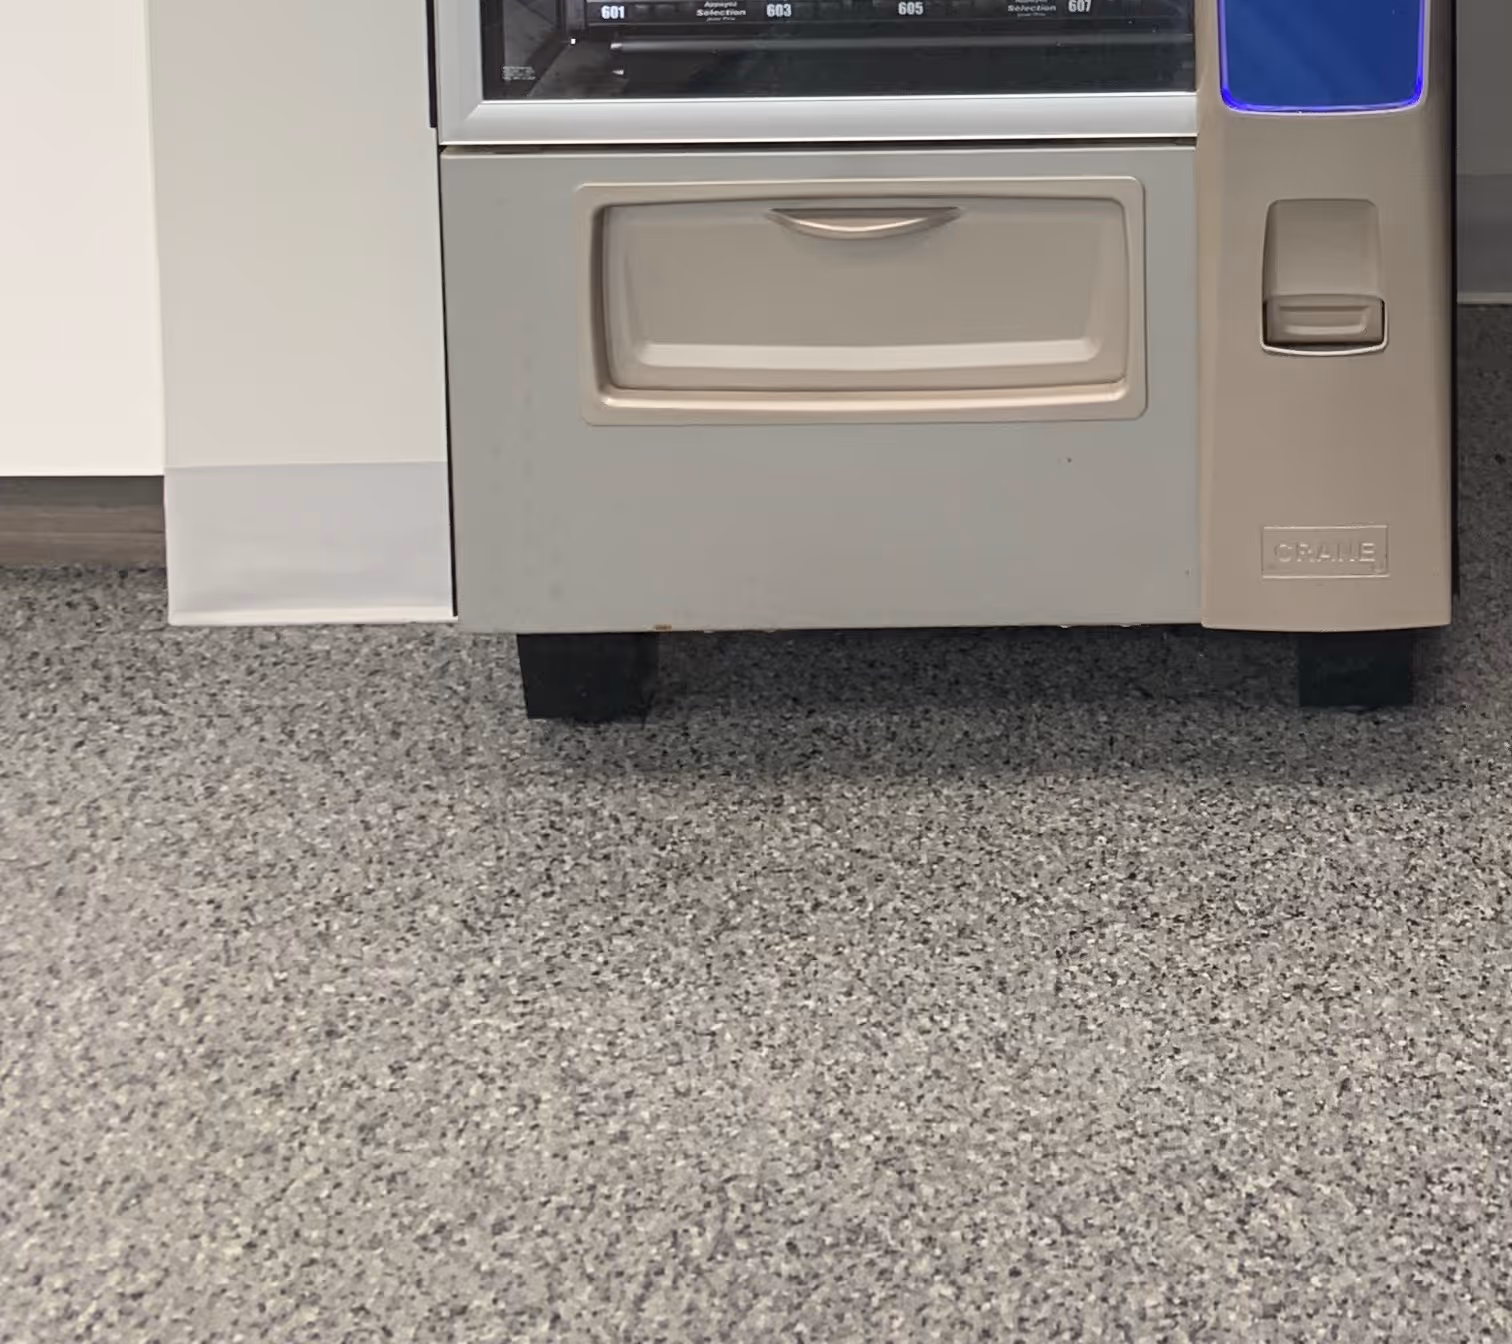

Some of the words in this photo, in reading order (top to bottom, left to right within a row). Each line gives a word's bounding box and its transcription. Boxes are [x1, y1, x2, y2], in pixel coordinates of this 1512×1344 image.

[601, 5, 625, 19] 601
[767, 4, 792, 18] 603
[898, 2, 923, 15] 605
[1068, 0, 1092, 12] 607
[1273, 542, 1376, 563] CRANE
